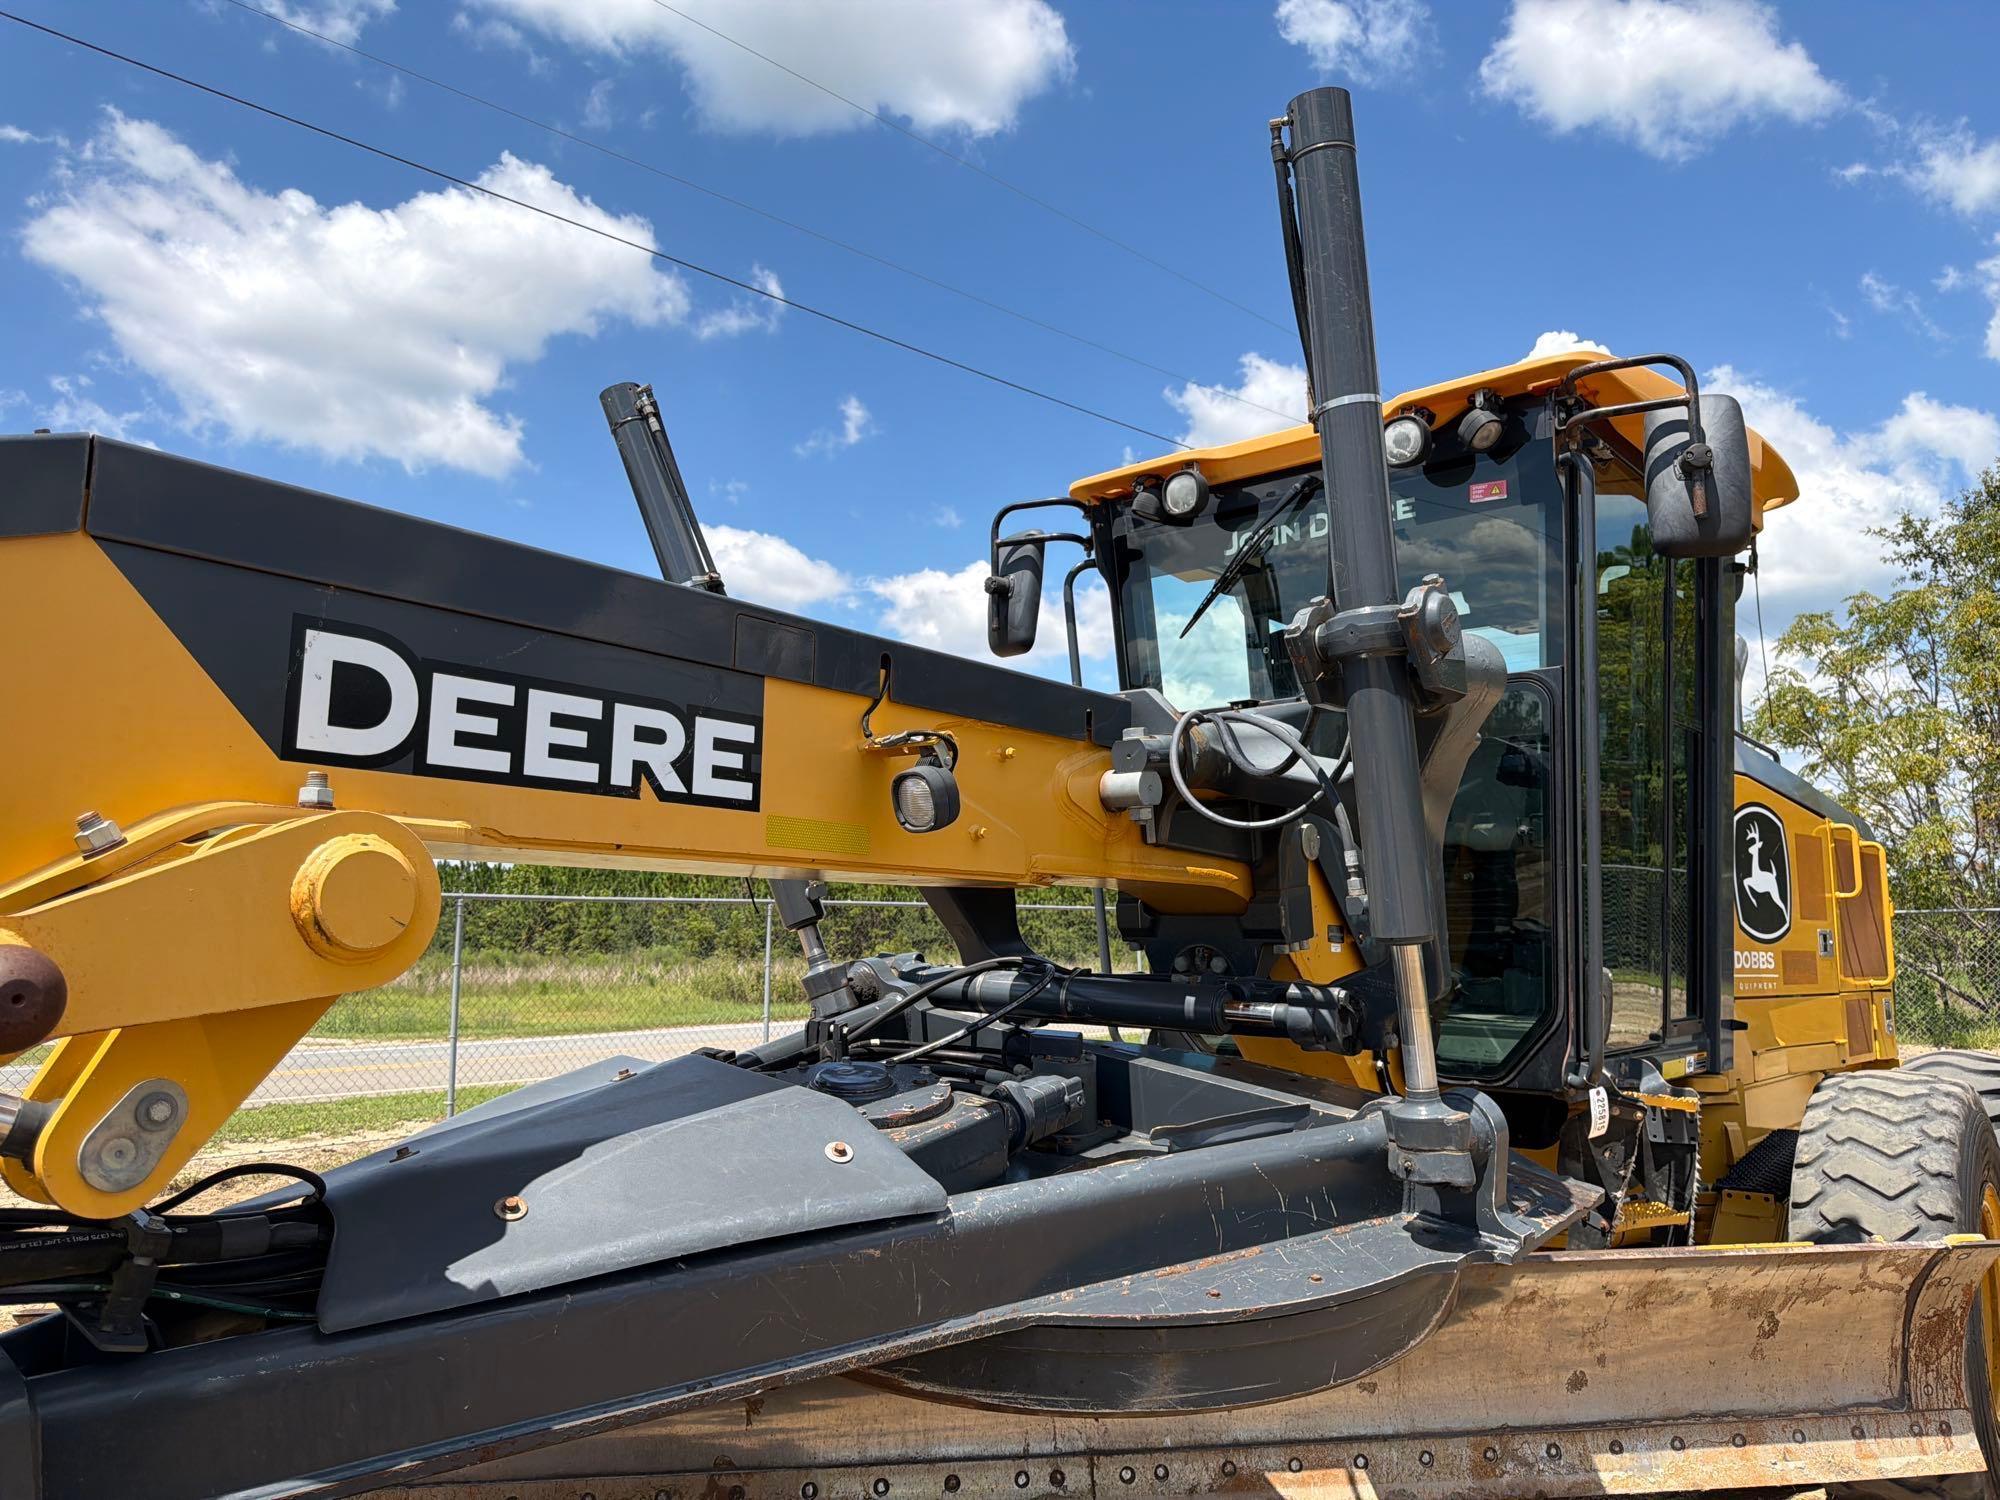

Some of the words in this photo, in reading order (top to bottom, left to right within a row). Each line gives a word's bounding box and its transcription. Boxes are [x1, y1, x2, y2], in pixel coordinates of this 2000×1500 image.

[296, 628, 756, 801] DEERE
[1734, 951, 1775, 969] DOBBS
[1739, 982, 1777, 991] QUIPMENT
[1596, 1097, 1606, 1131] 225815
